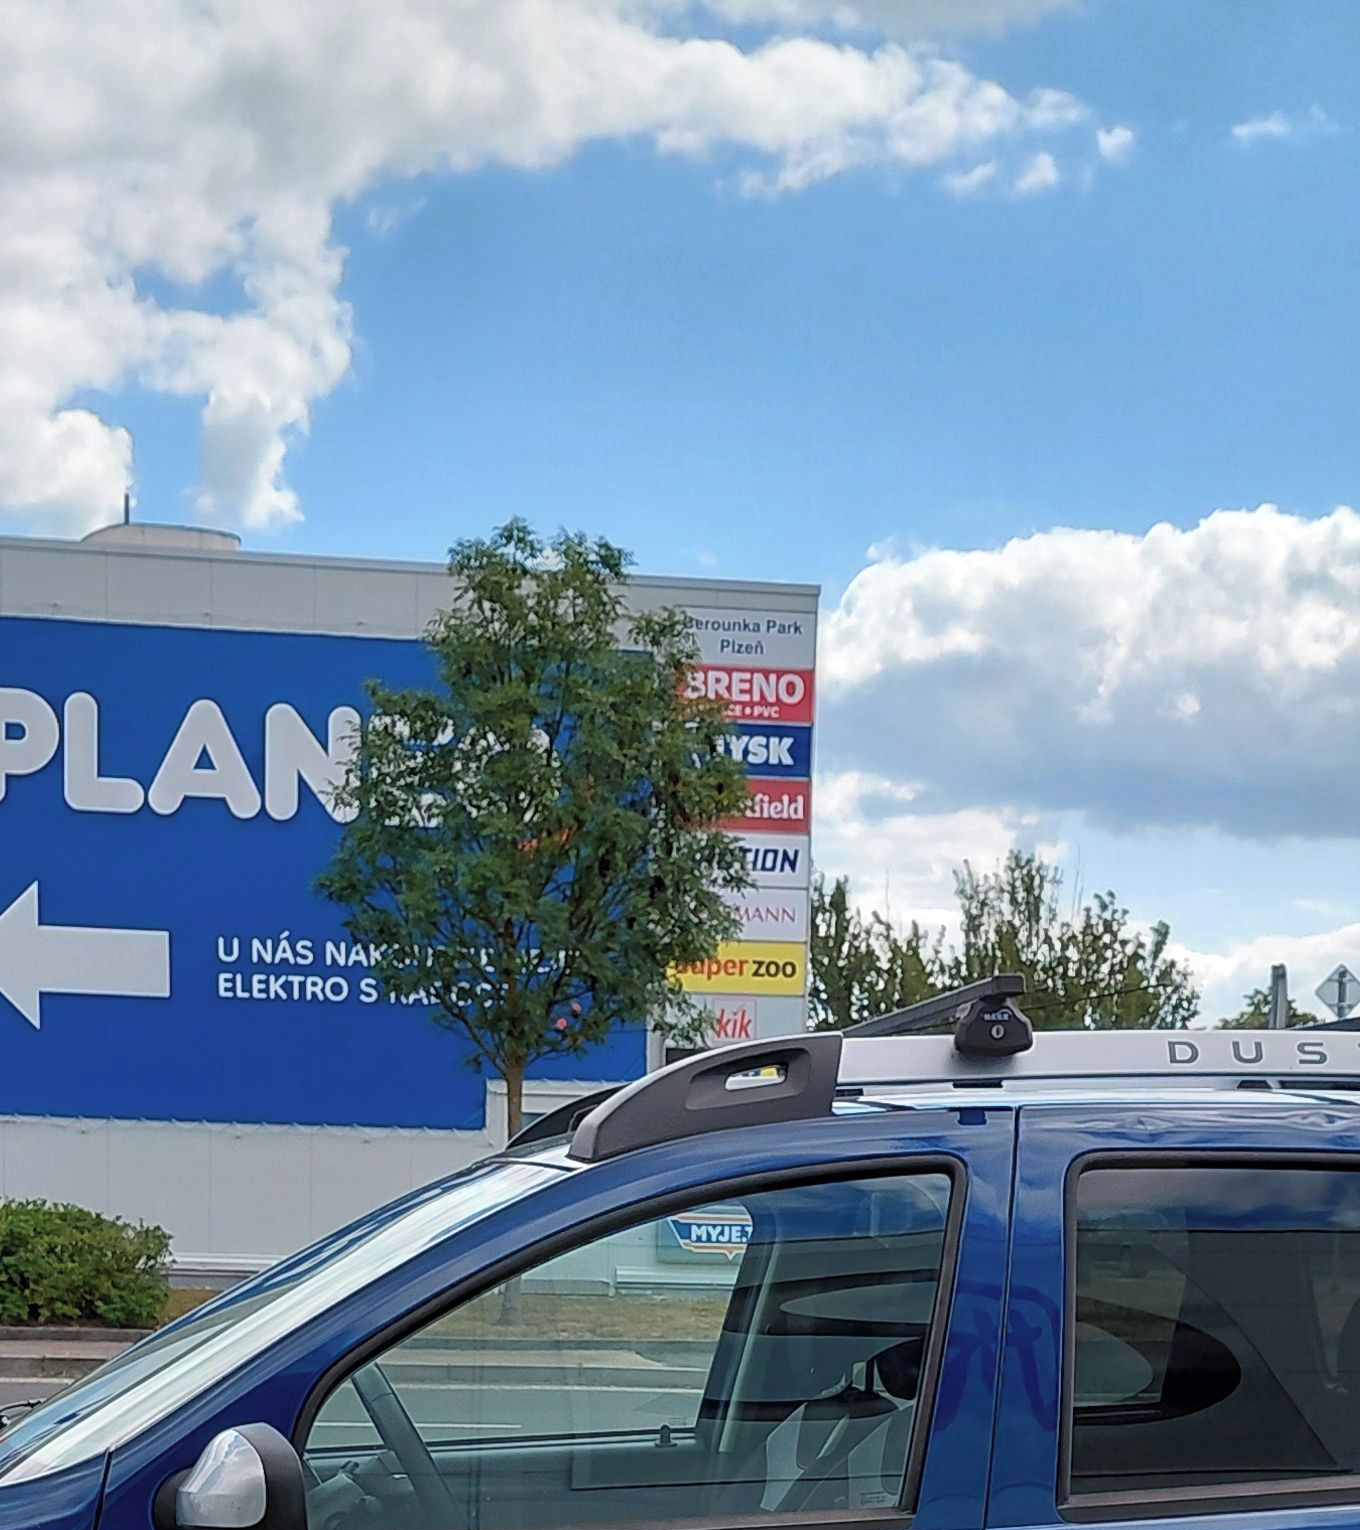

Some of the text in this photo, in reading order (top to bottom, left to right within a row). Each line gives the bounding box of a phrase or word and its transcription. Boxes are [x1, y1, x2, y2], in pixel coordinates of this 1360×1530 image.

[766, 619, 803, 635] Park
[720, 639, 764, 655] Plzeň
[686, 670, 805, 704] BRENO
[753, 705, 779, 718] PVC
[745, 792, 804, 819] field
[738, 906, 796, 922] MANN
[217, 936, 240, 963] U
[251, 930, 314, 965] NÁS
[752, 960, 798, 978] zoo
[218, 973, 349, 1002] ELEKTRO
[359, 977, 379, 1003] S
